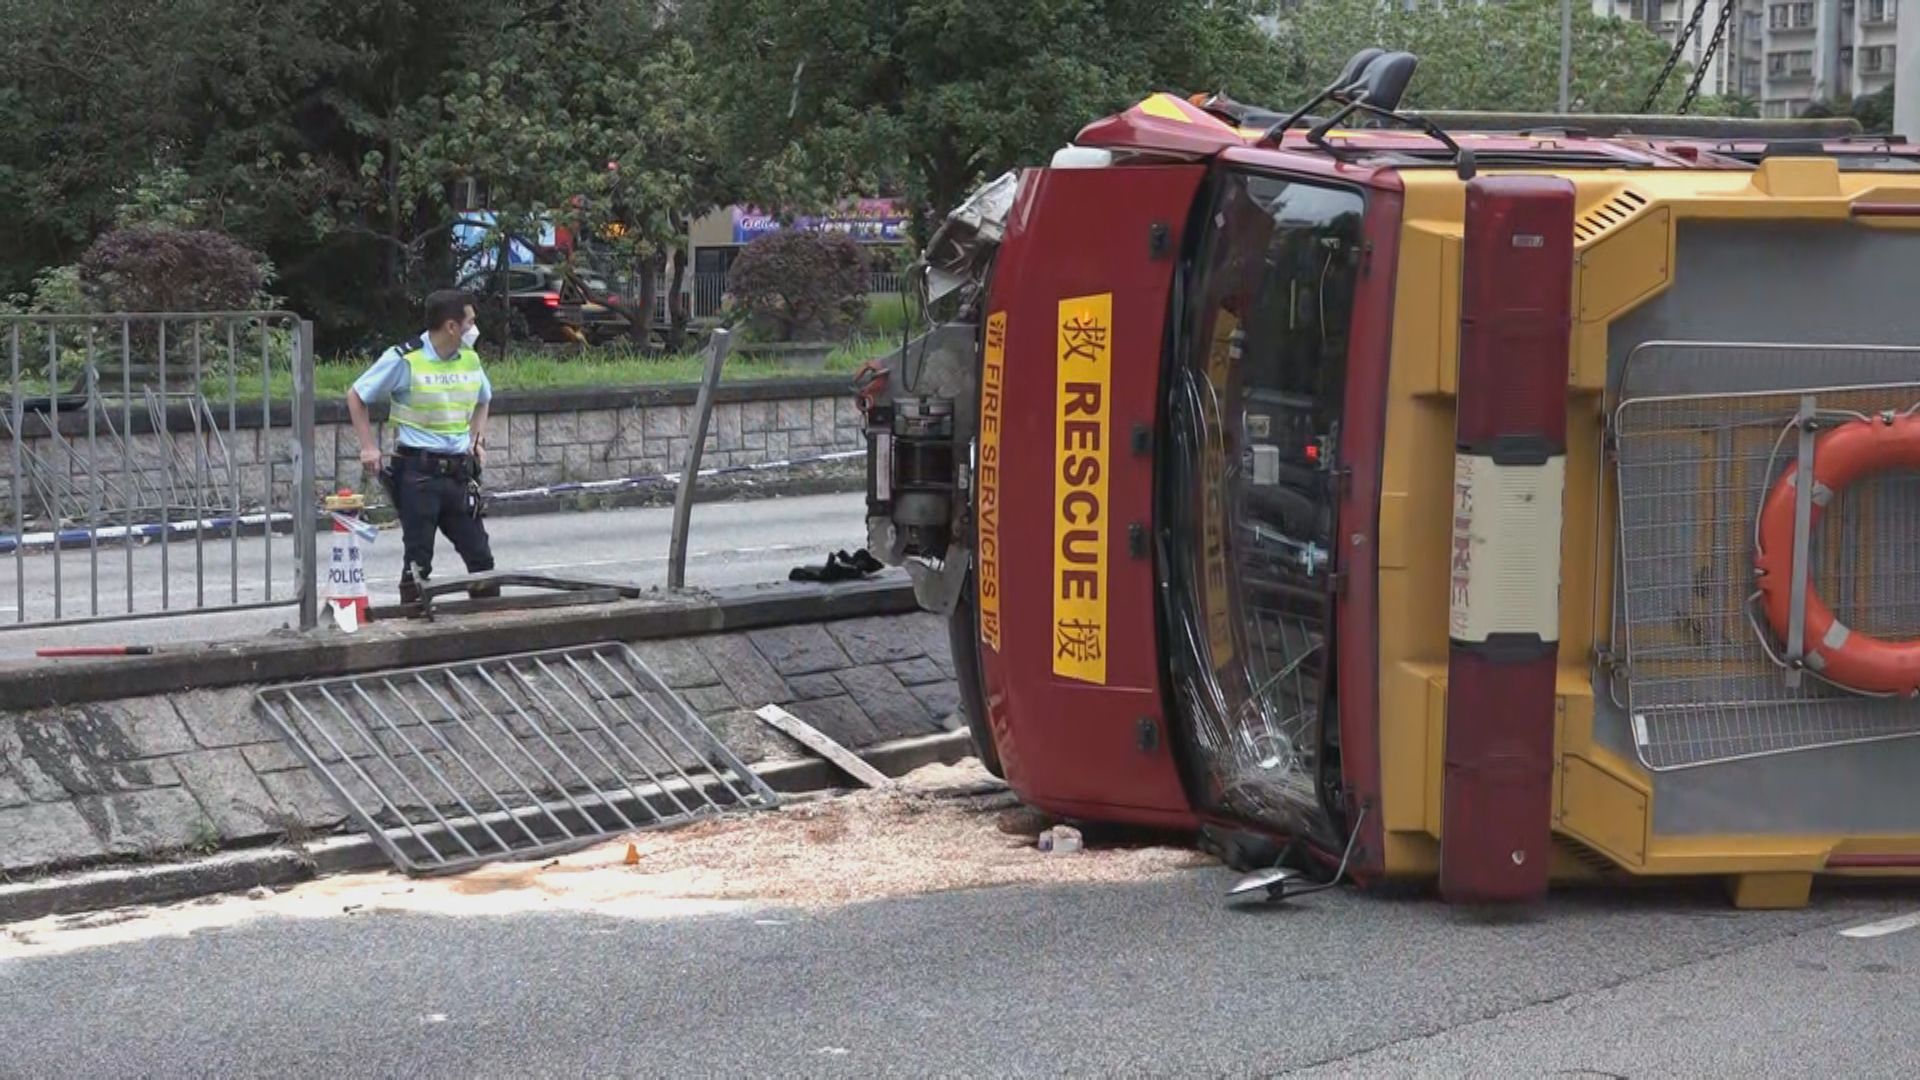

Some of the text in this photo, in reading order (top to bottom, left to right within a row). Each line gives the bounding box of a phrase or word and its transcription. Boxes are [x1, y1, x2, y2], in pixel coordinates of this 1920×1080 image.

[983, 364, 1001, 433] FIRE
[979, 443, 997, 598] SERVICES
[1056, 316, 1106, 663] 救 RESCUE 援
[329, 567, 365, 584] POLICE
